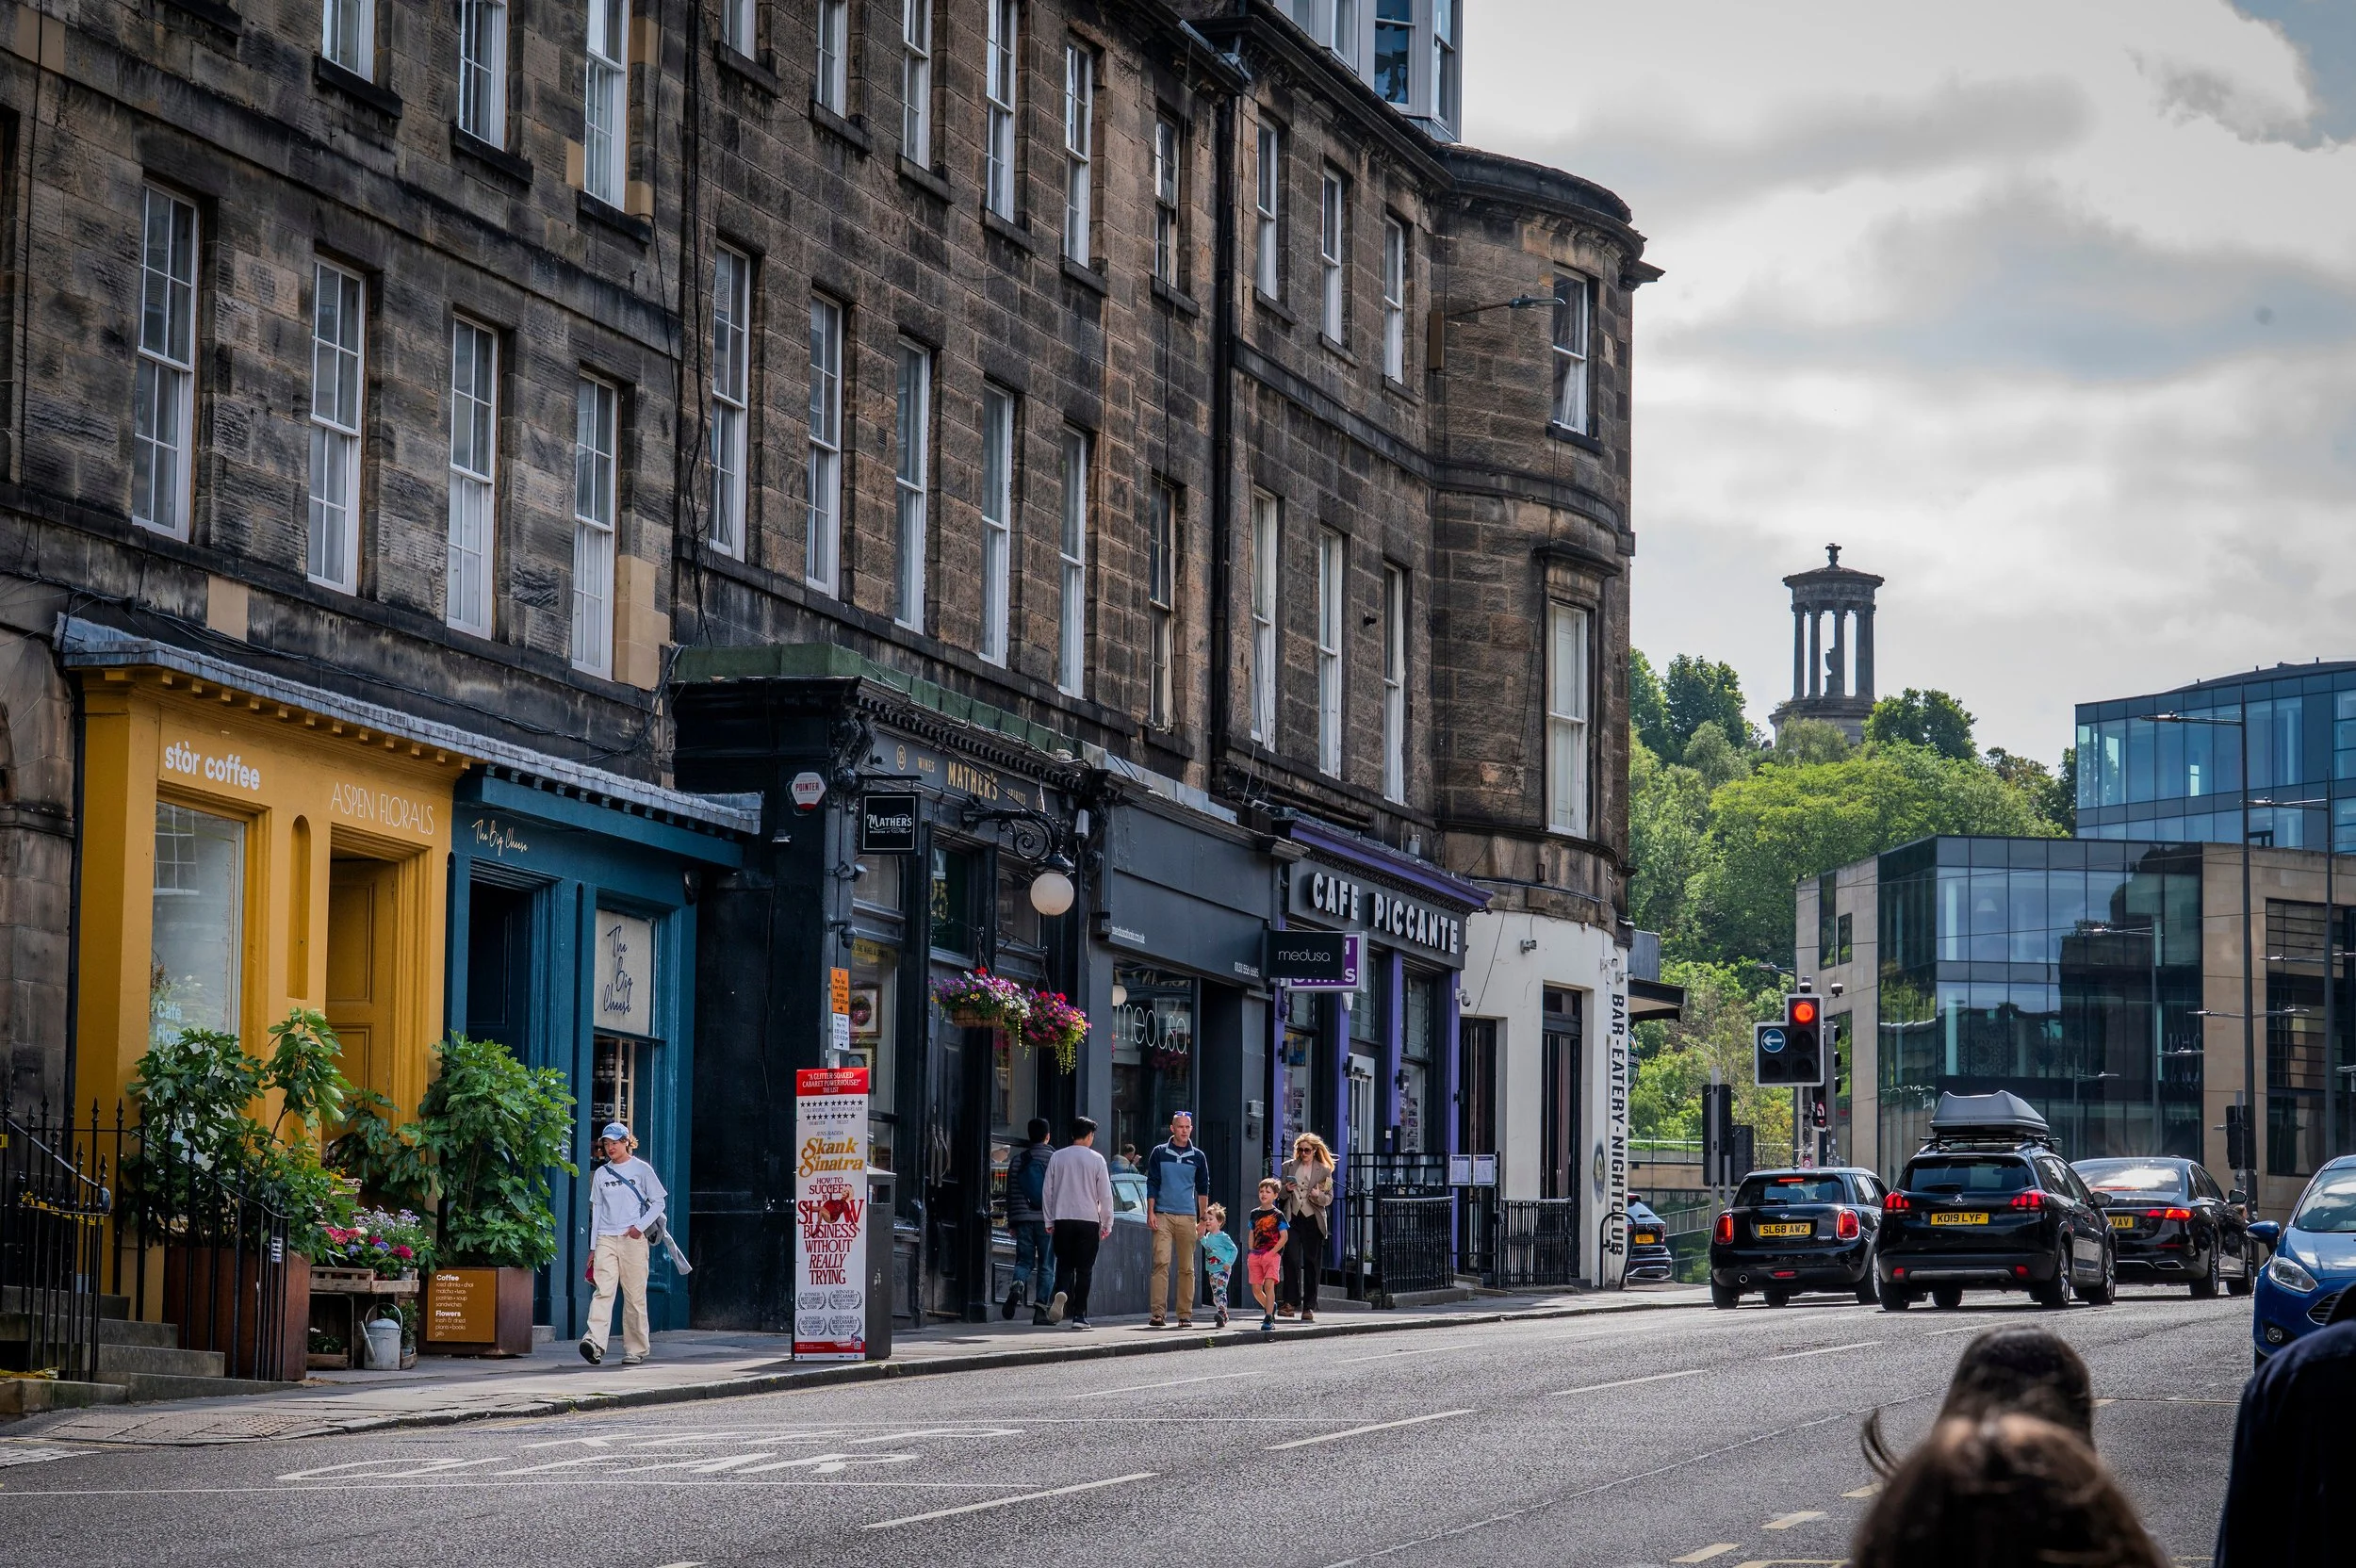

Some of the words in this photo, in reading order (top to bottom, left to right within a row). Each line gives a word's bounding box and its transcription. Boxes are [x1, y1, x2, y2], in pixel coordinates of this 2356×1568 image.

[165, 741, 200, 776] stòr
[205, 754, 260, 791] coffee
[917, 756, 935, 773] WINES
[795, 782, 820, 792] POINTER
[947, 760, 998, 801] MATHER'S
[330, 782, 374, 821] ASPEN
[380, 793, 434, 836] FLORALS
[471, 818, 488, 844] The
[489, 820, 504, 857] Big
[505, 827, 529, 852] Cheese
[1313, 872, 1359, 921] CAFE
[1374, 892, 1458, 955] PICCANTE
[607, 924, 628, 957] The
[1278, 949, 1330, 962] medusa
[614, 956, 633, 997] Big
[603, 984, 632, 1016] Cheese
[1612, 992, 1625, 1036] BAR
[1116, 998, 1187, 1055] medusa
[1612, 1048, 1625, 1125] EATERY
[801, 1136, 859, 1159] Skank
[798, 1156, 864, 1178] Sinatra
[1612, 1135, 1625, 1256] NIGHTCLUB
[797, 1200, 864, 1225] SHW
[1937, 1214, 1959, 1223] KO19
[1961, 1214, 1982, 1222] LYF
[803, 1223, 857, 1239] BUSINESS
[1763, 1225, 1787, 1234] SL68
[1789, 1225, 1807, 1233] AWZ
[805, 1239, 853, 1253] WITHOUT
[809, 1253, 846, 1269] REALLY
[809, 1269, 846, 1285] TRYING
